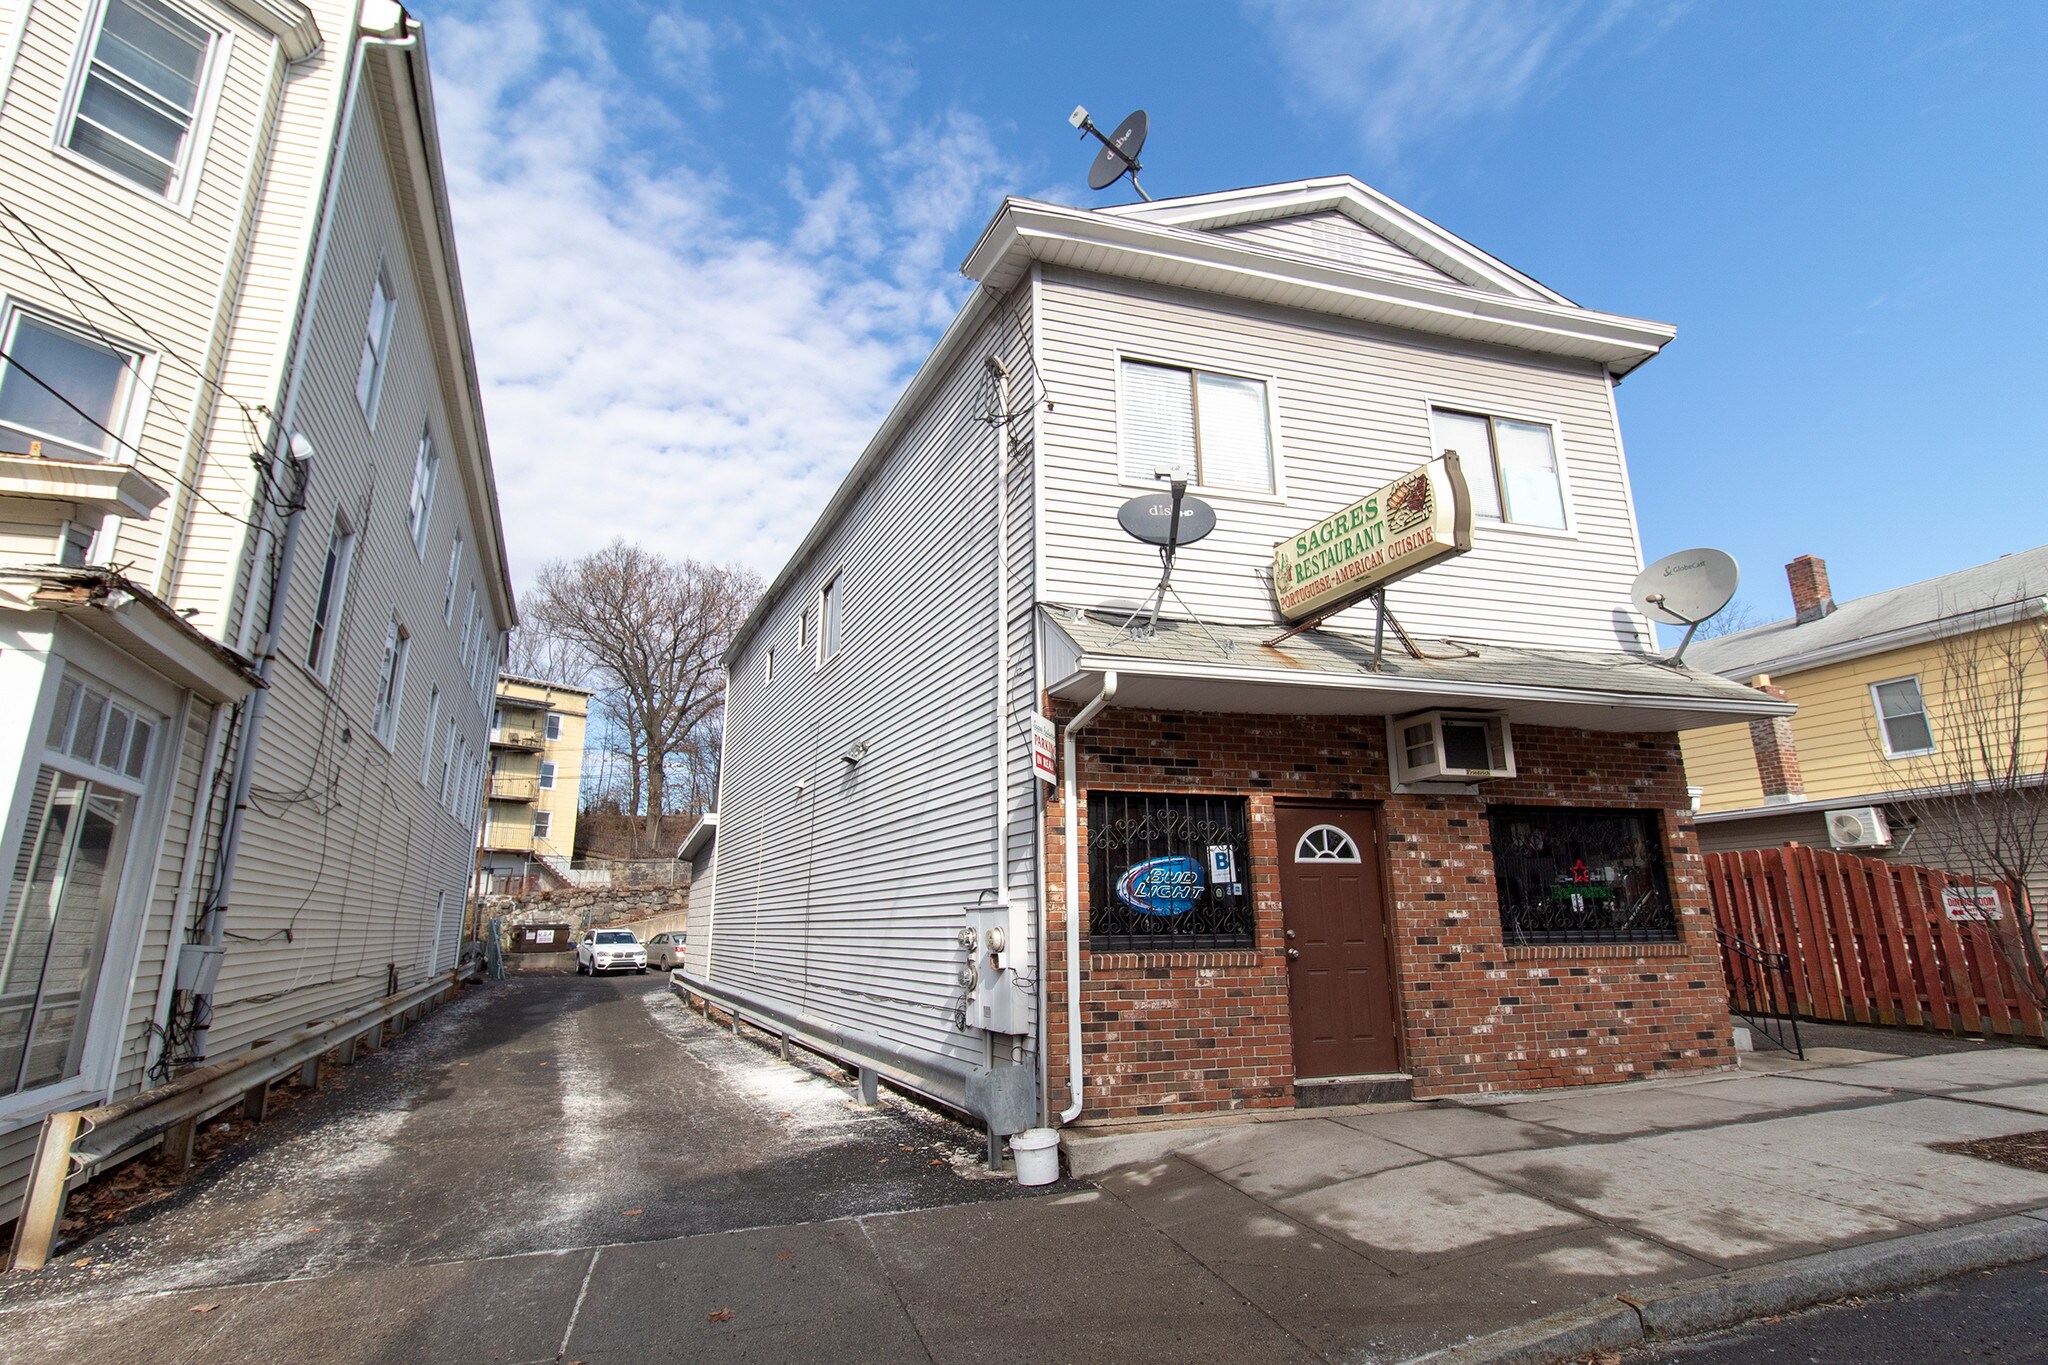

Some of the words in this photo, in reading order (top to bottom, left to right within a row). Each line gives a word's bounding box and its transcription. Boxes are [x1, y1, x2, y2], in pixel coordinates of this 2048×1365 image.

[1149, 504, 1173, 516] dis
[1295, 497, 1380, 558] SAGRES
[1294, 520, 1385, 584] RESTAURANT
[1279, 550, 1386, 611] PORTUGUESE-AMERICAN
[1388, 526, 1434, 561] CUISINE
[1672, 561, 1706, 574] GlobeCast
[1036, 754, 1042, 766] IN
[1215, 852, 1229, 870] B
[1146, 868, 1198, 885] BUD
[1133, 882, 1205, 898] LIGHT
[1974, 896, 1996, 906] OOM
